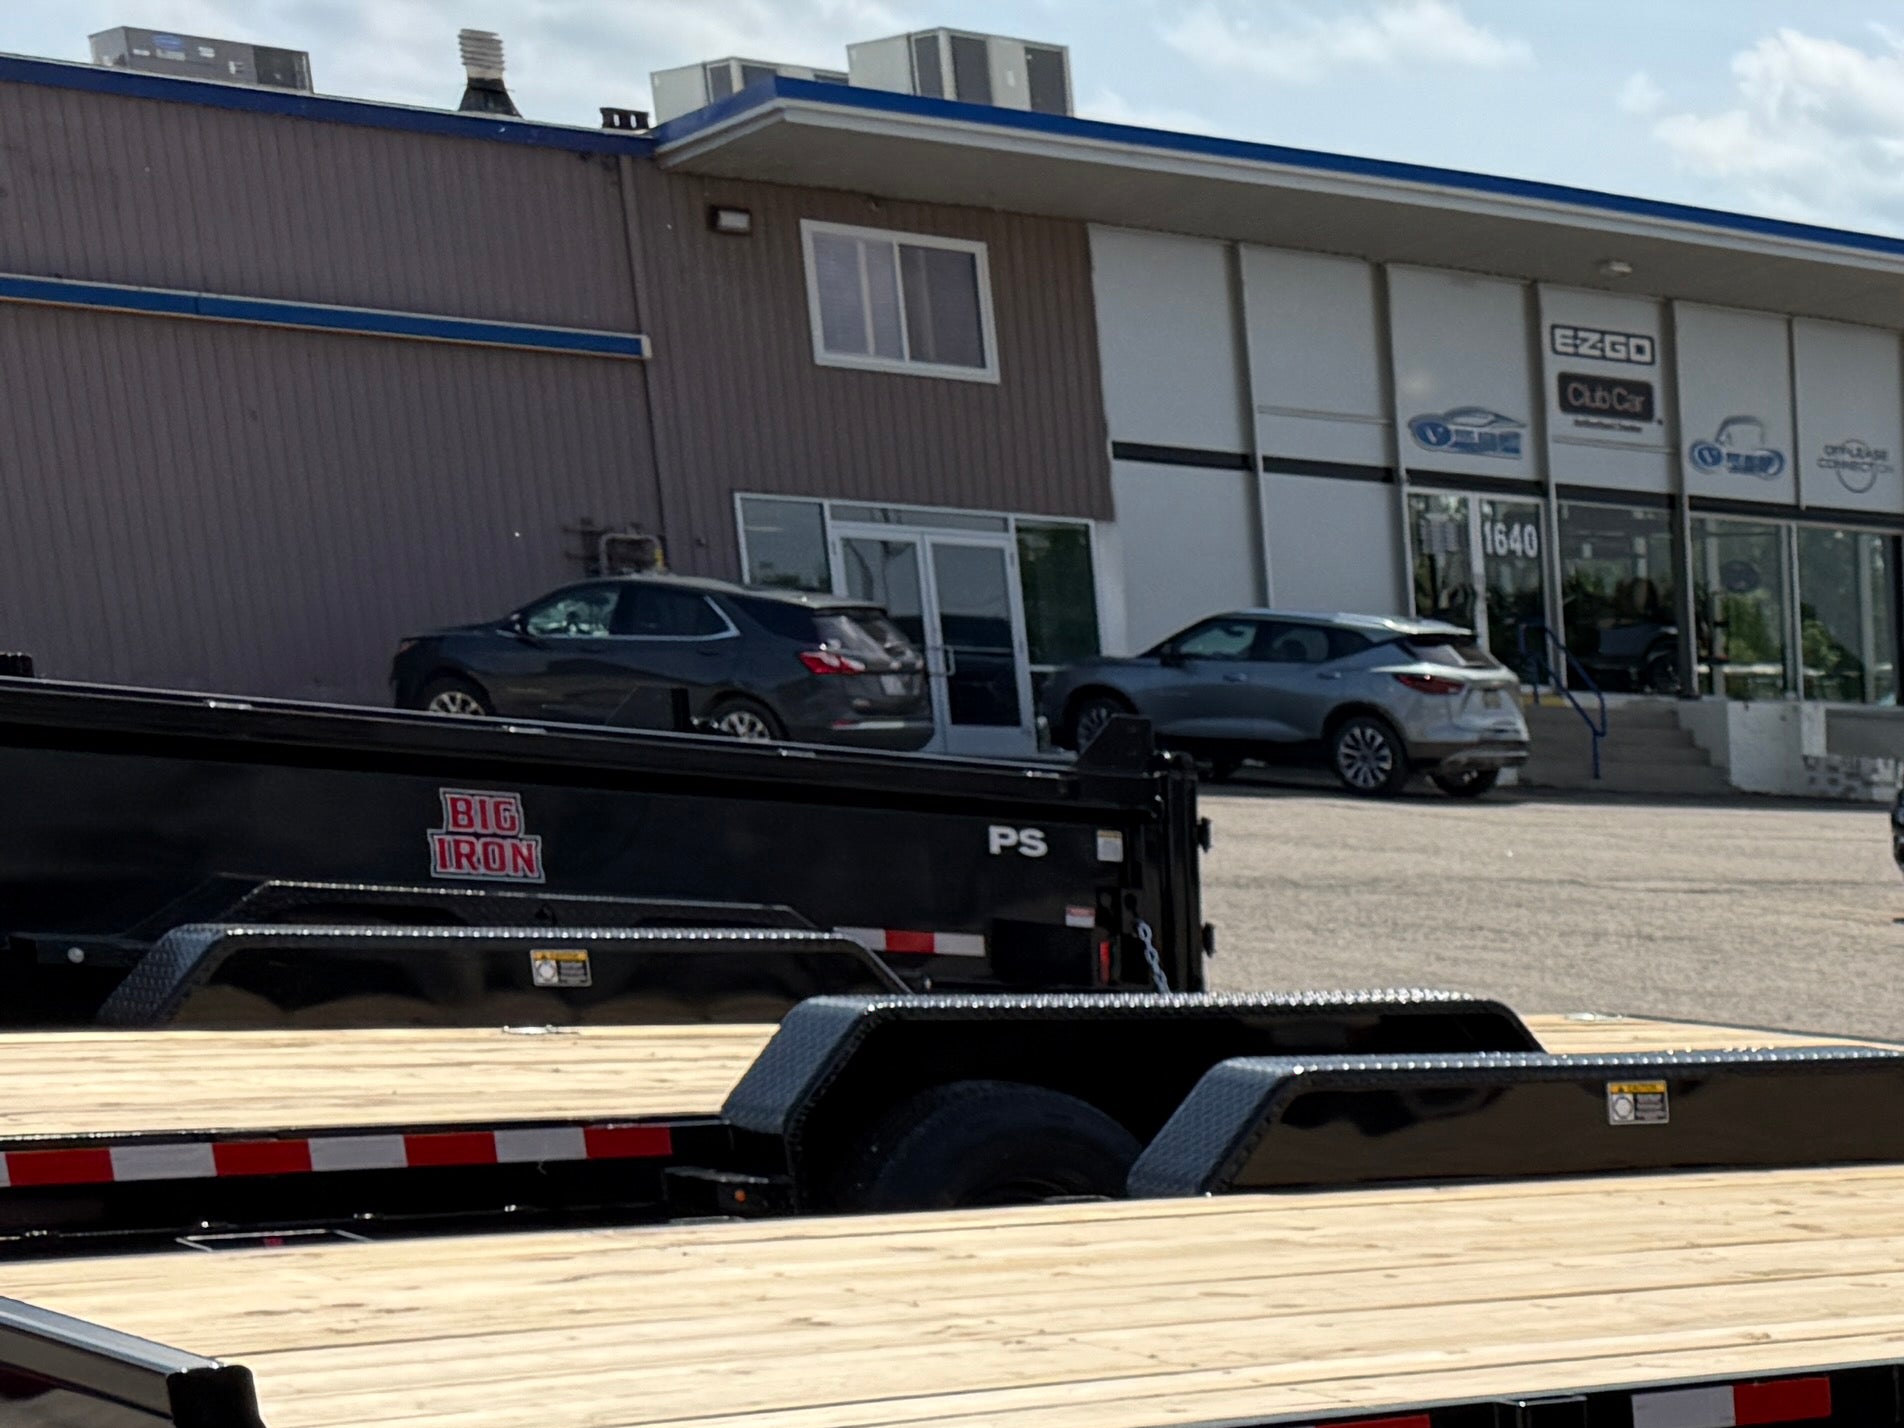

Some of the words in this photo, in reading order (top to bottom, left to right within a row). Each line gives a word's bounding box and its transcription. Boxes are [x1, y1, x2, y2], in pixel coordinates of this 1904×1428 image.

[1484, 520, 1538, 558] 1640
[446, 795, 519, 835] BIG
[434, 835, 539, 877] IRON
[988, 824, 1049, 858] PS
